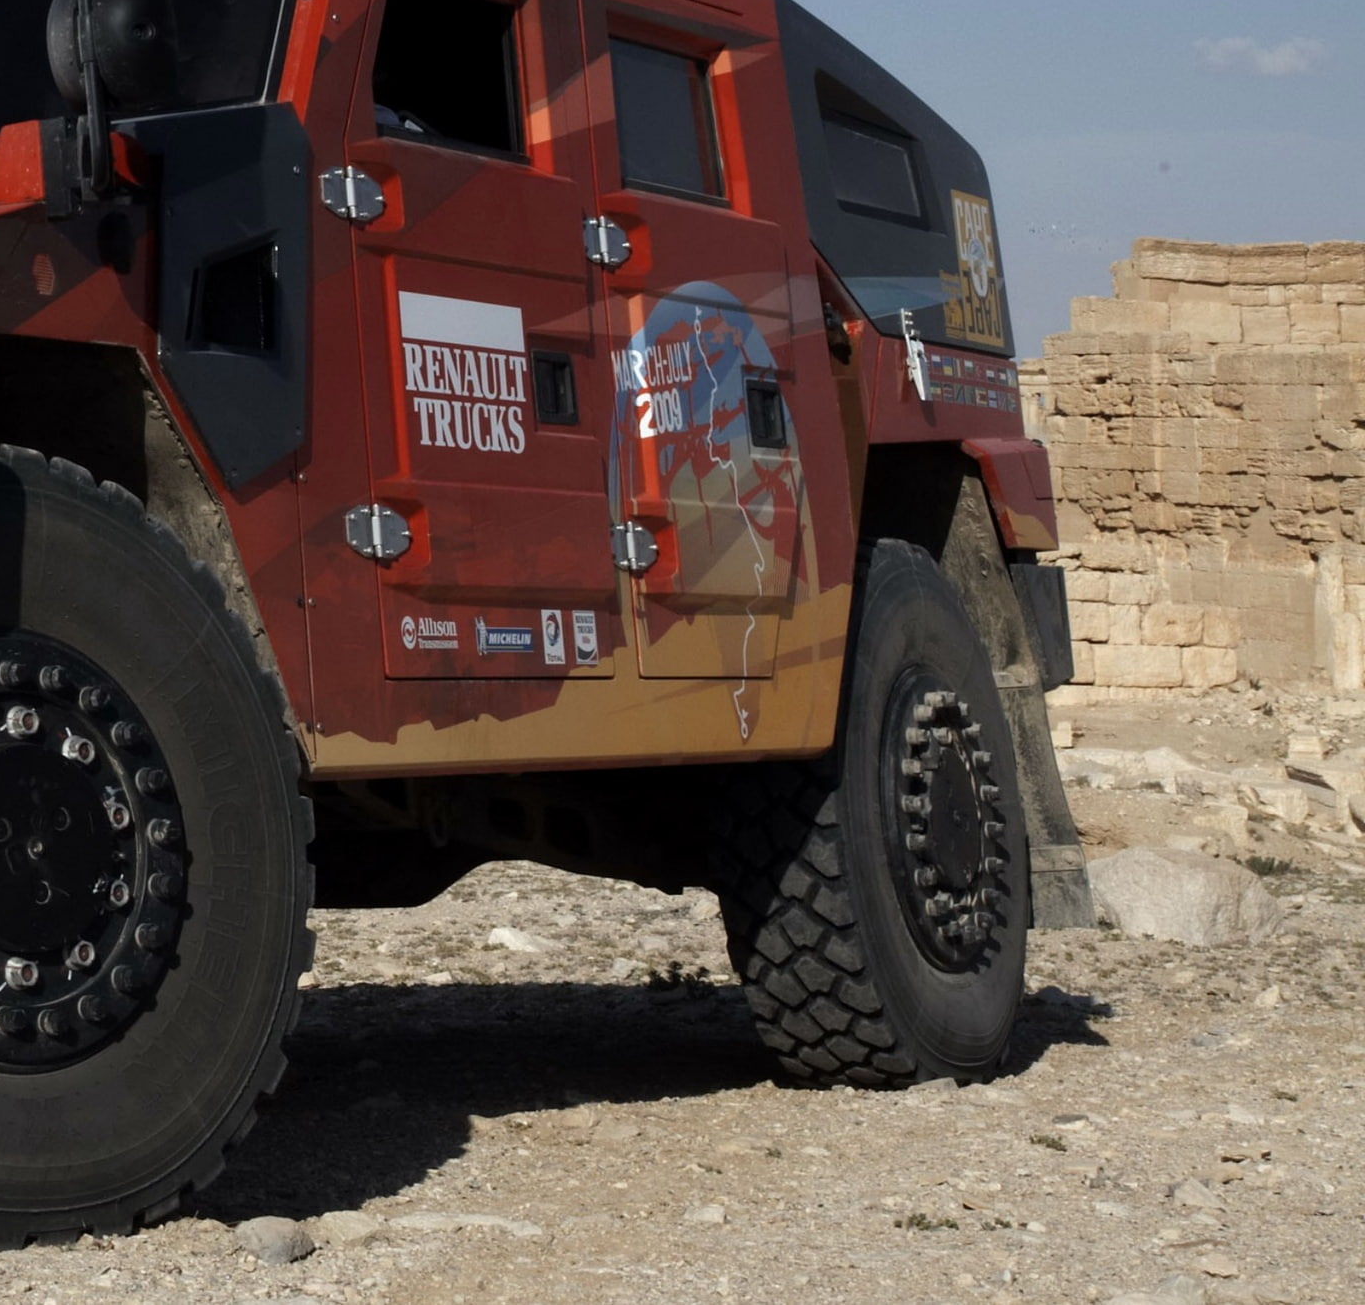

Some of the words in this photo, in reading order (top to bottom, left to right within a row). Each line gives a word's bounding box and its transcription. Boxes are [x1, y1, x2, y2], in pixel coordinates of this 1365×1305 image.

[402, 342, 527, 402] RENAULT
[611, 341, 692, 393] MARCH-JULY
[413, 397, 526, 454] TRUCKS
[635, 388, 684, 439] 2009
[418, 616, 458, 637] Allison
[488, 632, 532, 645] MICHELIN
